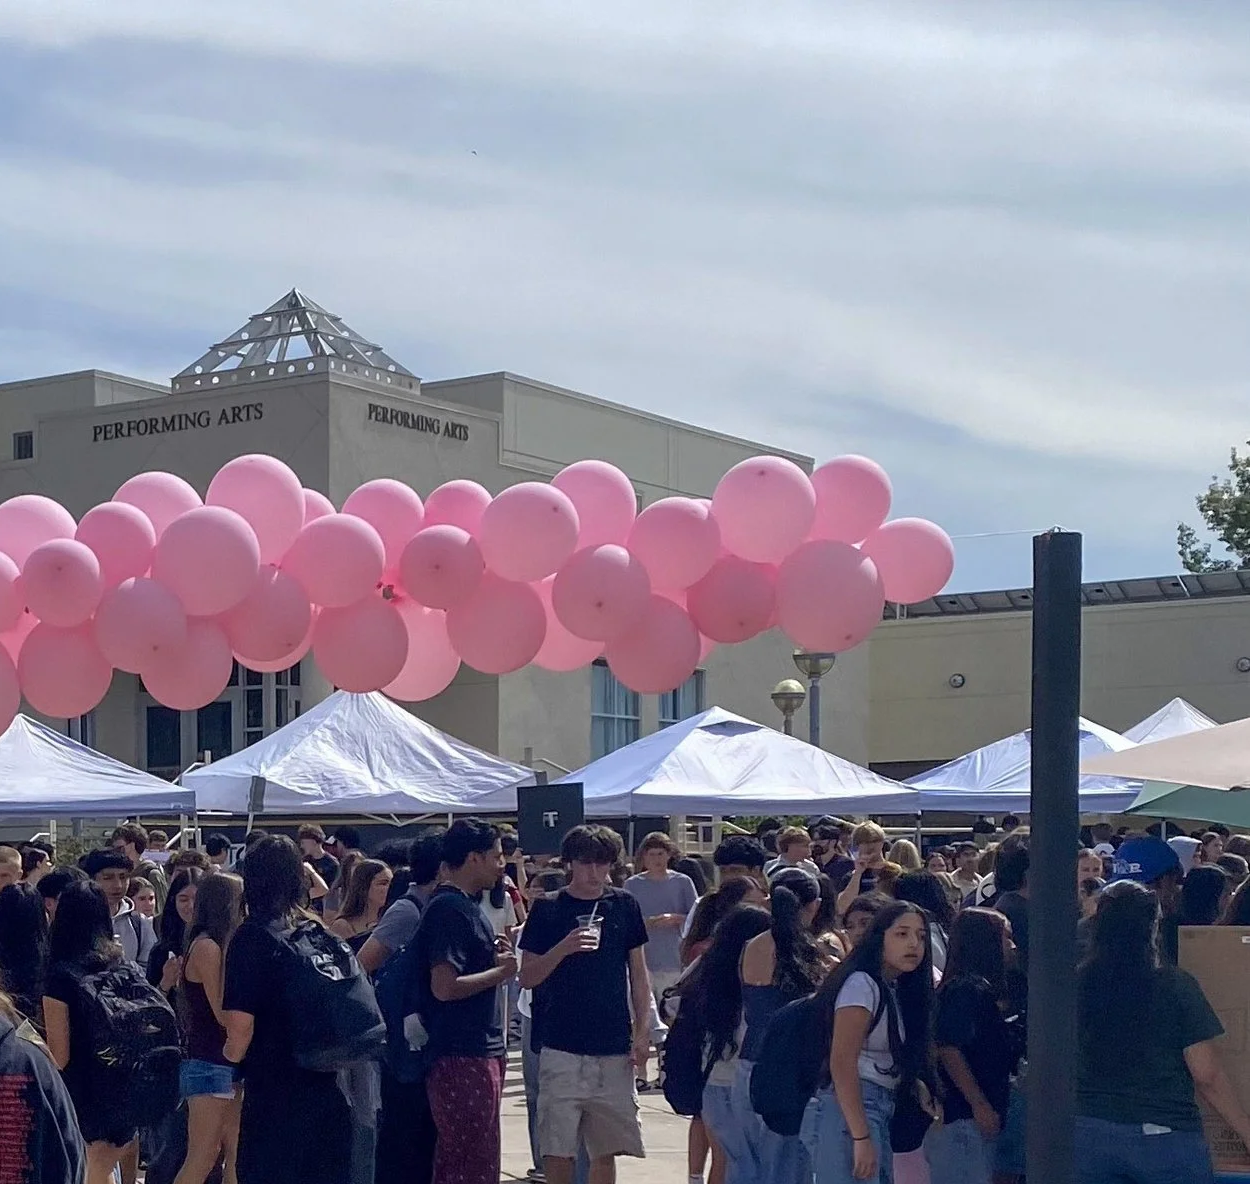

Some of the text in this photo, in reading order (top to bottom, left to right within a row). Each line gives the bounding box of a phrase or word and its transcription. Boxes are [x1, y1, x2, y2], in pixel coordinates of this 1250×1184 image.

[92, 402, 264, 442] PERFORMING ARTS
[367, 403, 470, 441] PERFORMING ARTS
